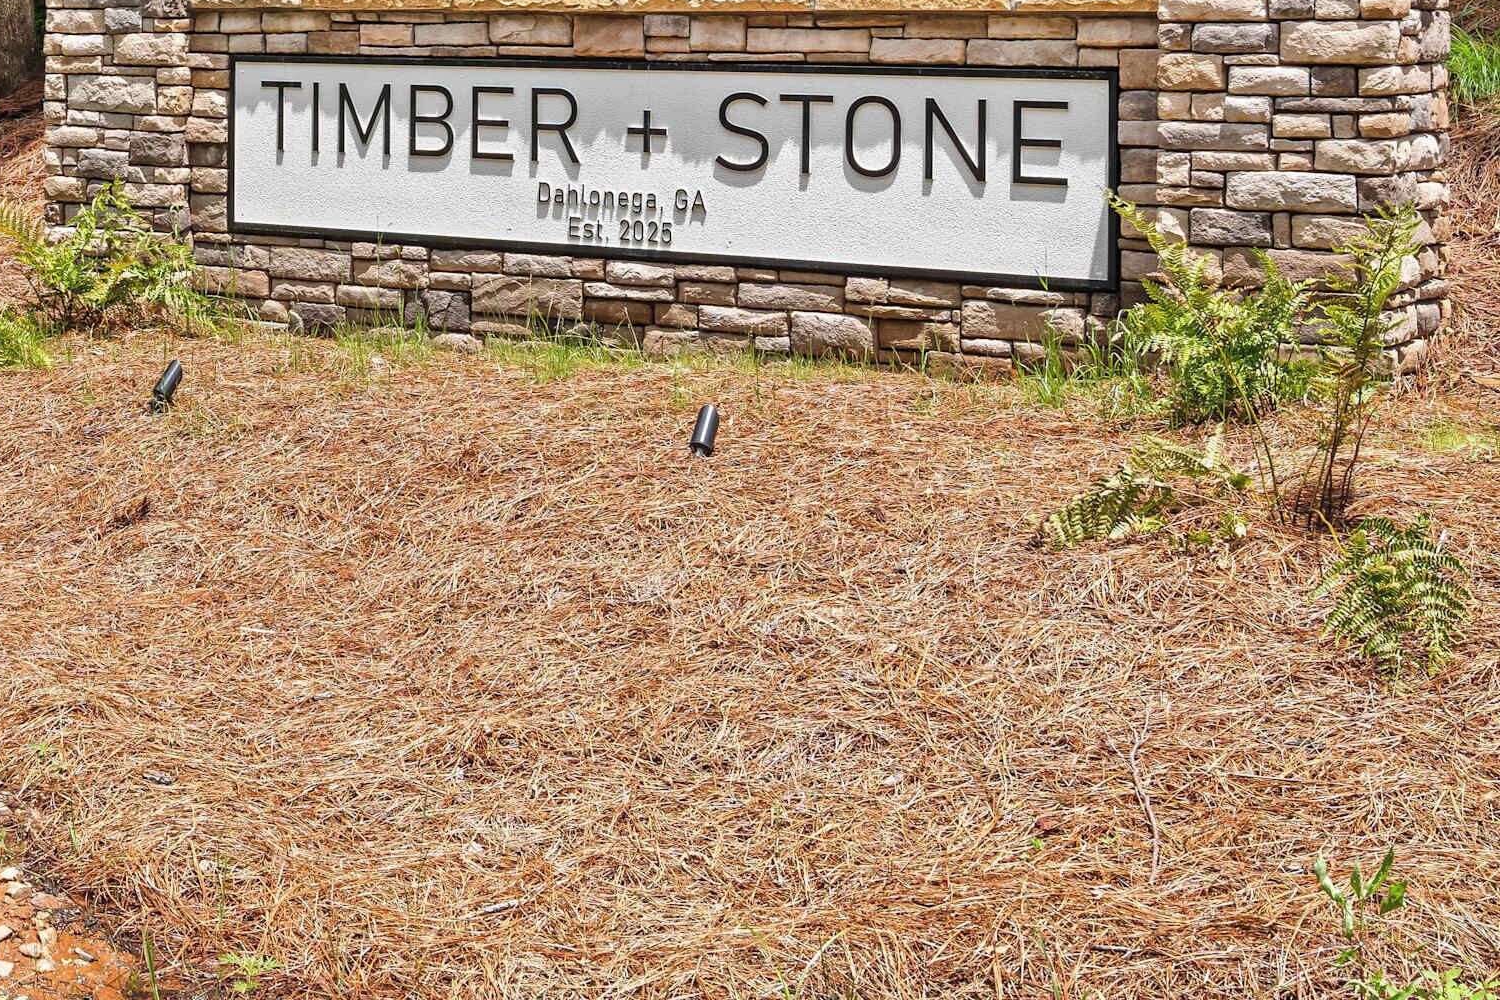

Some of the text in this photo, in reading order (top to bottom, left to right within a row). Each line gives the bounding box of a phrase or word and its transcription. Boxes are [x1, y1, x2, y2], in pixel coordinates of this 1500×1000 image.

[261, 80, 1069, 185] TIMBER + STONE
[538, 181, 707, 217] Dahlonega, GA
[619, 219, 673, 244] 2025
